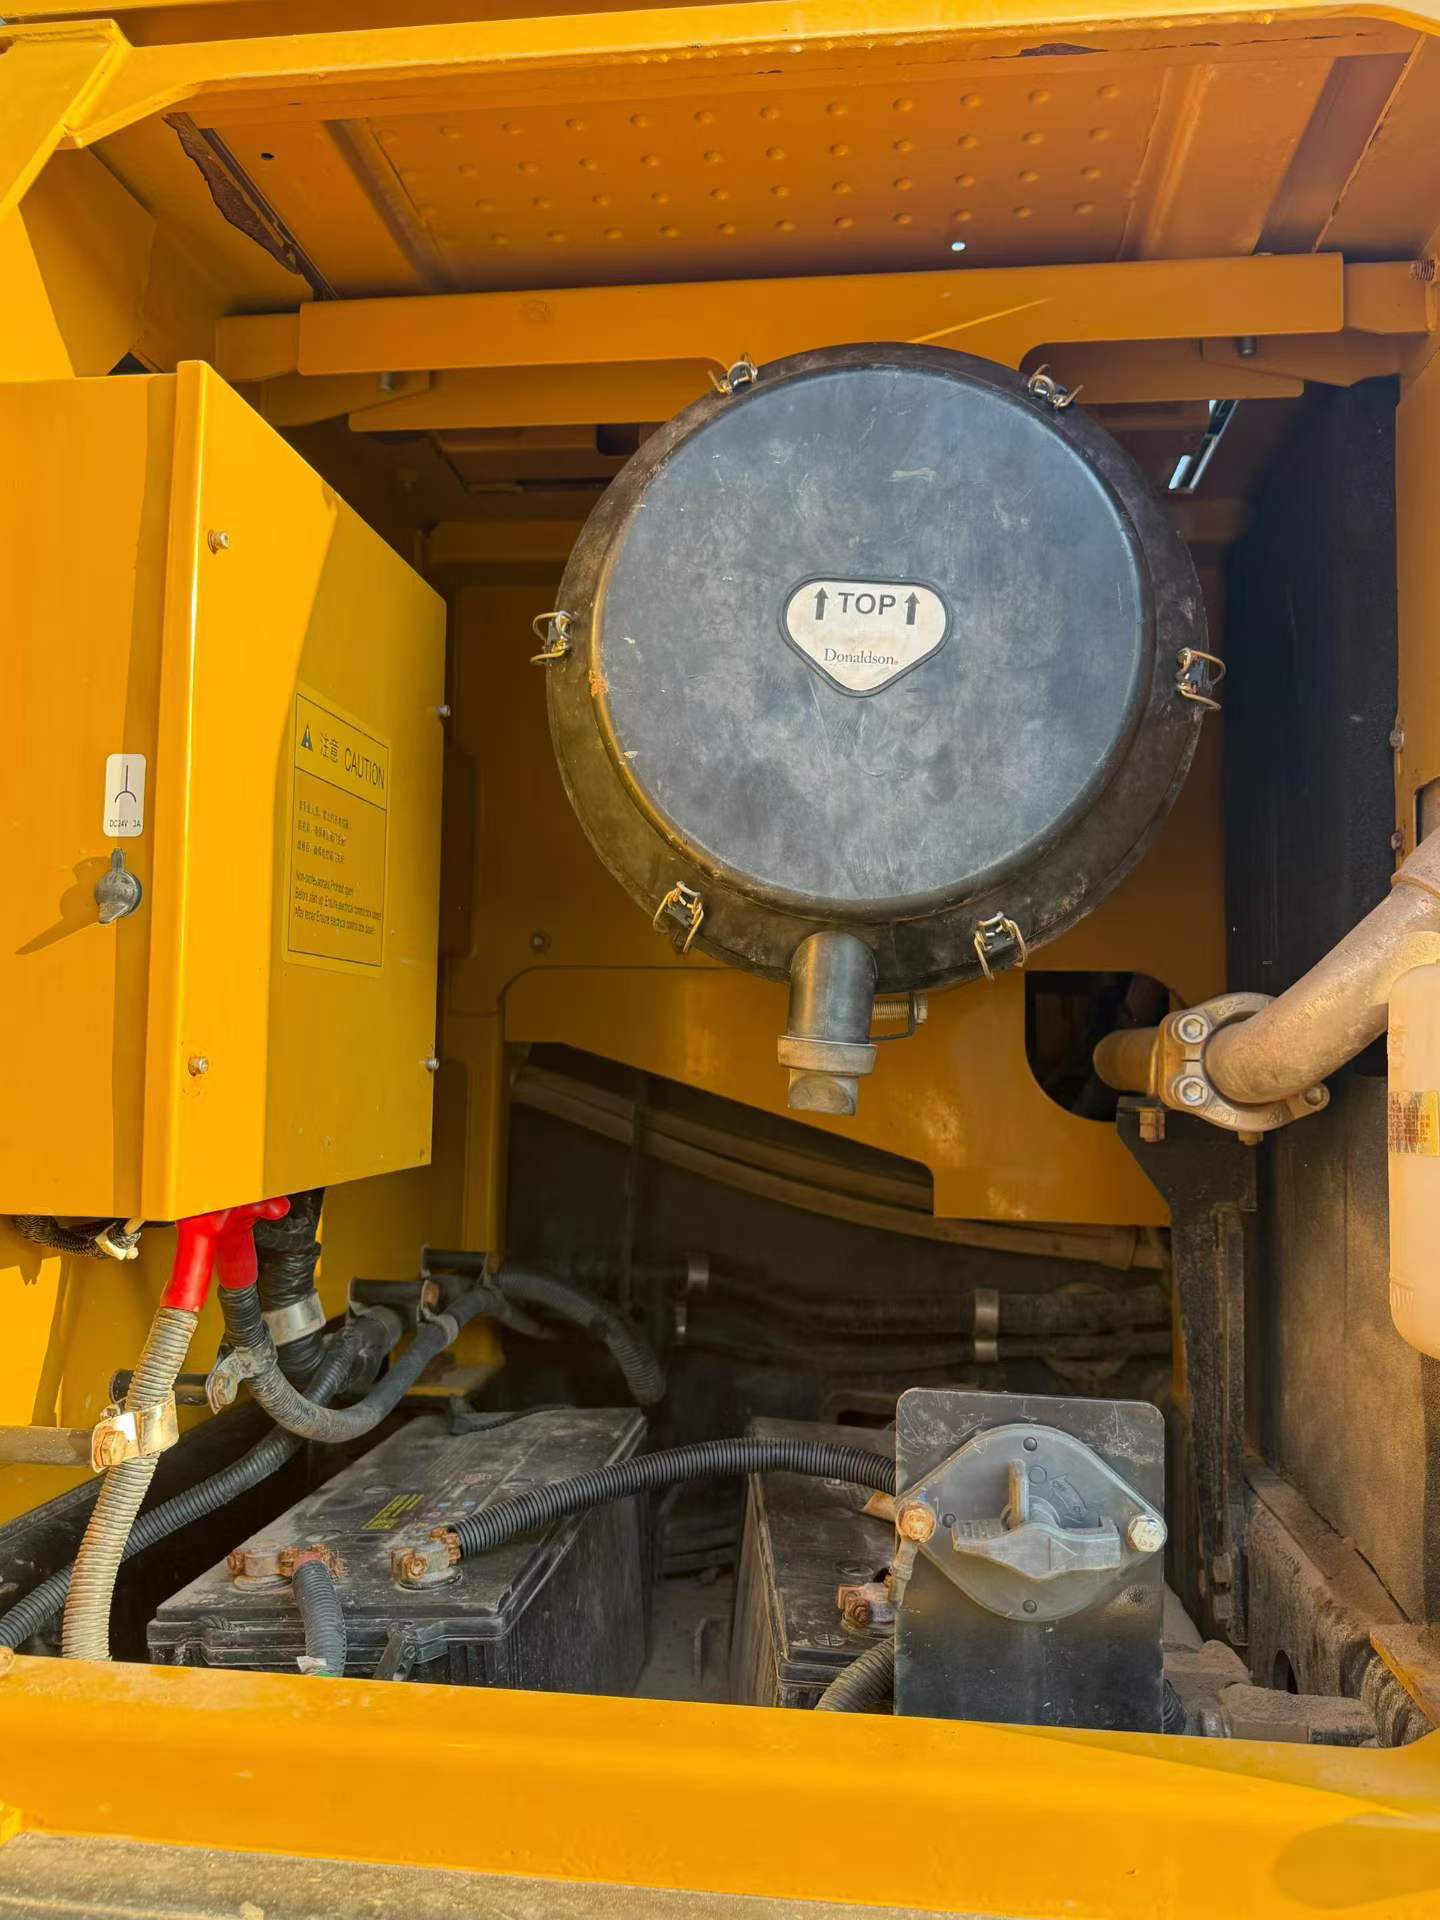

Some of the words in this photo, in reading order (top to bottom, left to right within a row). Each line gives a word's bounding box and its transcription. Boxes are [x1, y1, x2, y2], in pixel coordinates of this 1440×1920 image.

[838, 592, 896, 615] TOP
[824, 648, 895, 666] Donaldson
[319, 732, 339, 763] 注意
[345, 748, 384, 789] CAUTION
